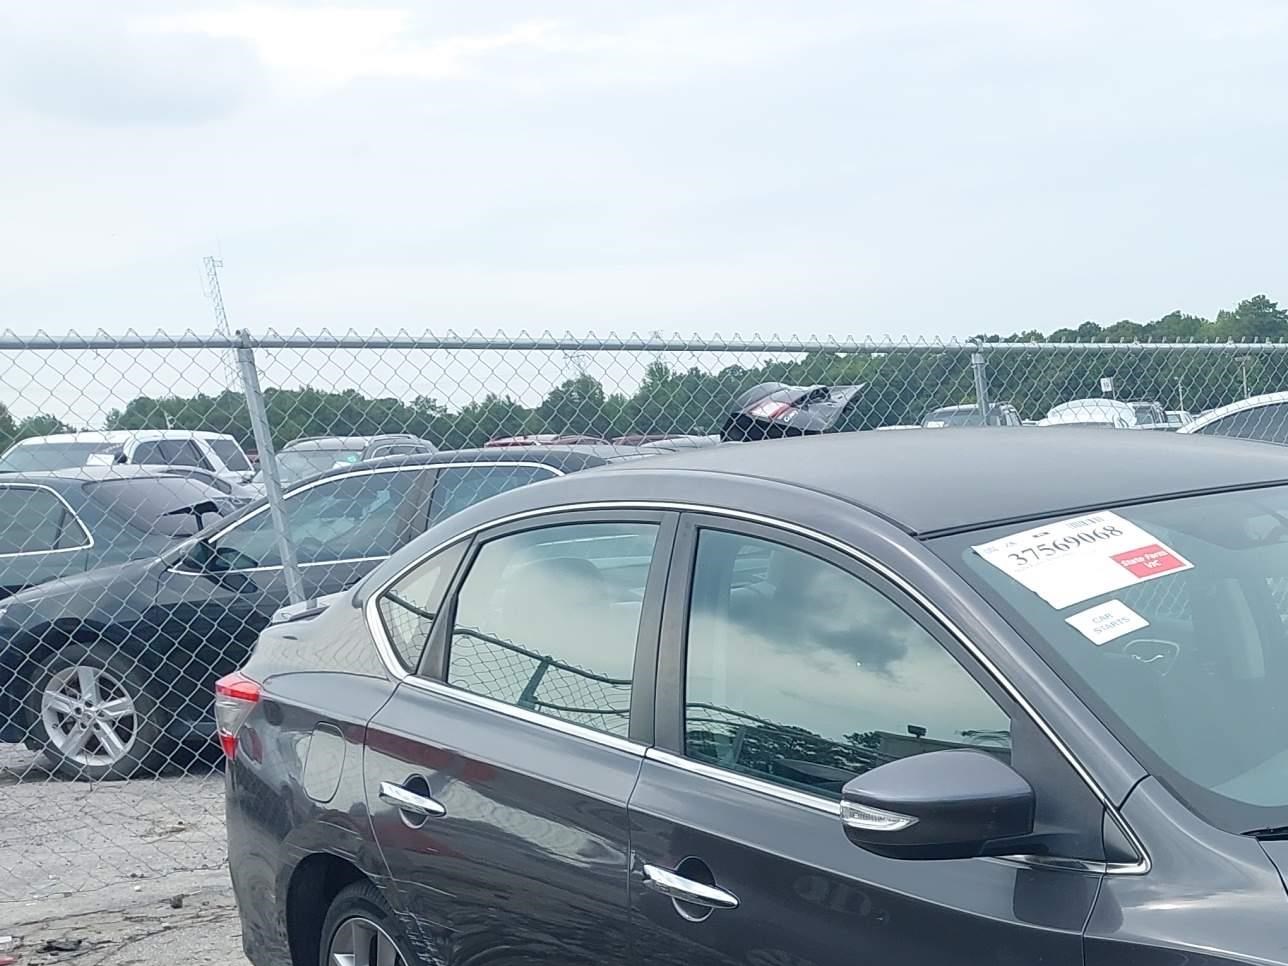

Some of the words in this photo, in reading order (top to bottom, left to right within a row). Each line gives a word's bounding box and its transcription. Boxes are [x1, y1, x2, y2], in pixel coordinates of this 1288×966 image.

[1008, 525, 1124, 566] 37569068
[1092, 612, 1114, 625] CAR
[1092, 616, 1130, 635] STARTS
